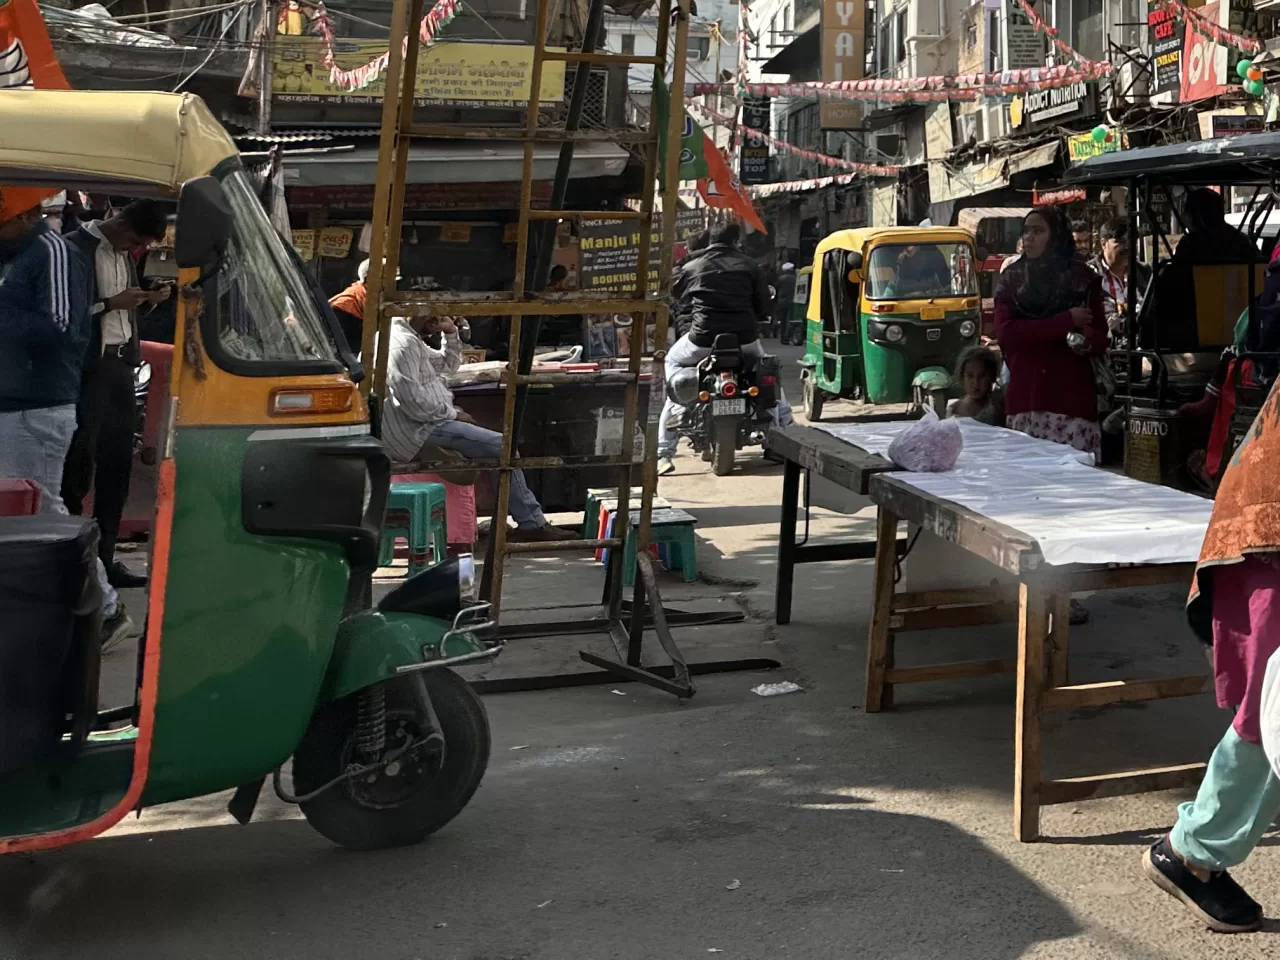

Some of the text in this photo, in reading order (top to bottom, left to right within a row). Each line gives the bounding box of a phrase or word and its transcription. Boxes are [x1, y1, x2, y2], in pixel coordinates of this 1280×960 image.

[1024, 90, 1049, 115] ADDICT
[1050, 80, 1087, 107] NUTRITION
[581, 235, 627, 251] Manju
[592, 272, 637, 285] BOOKING
